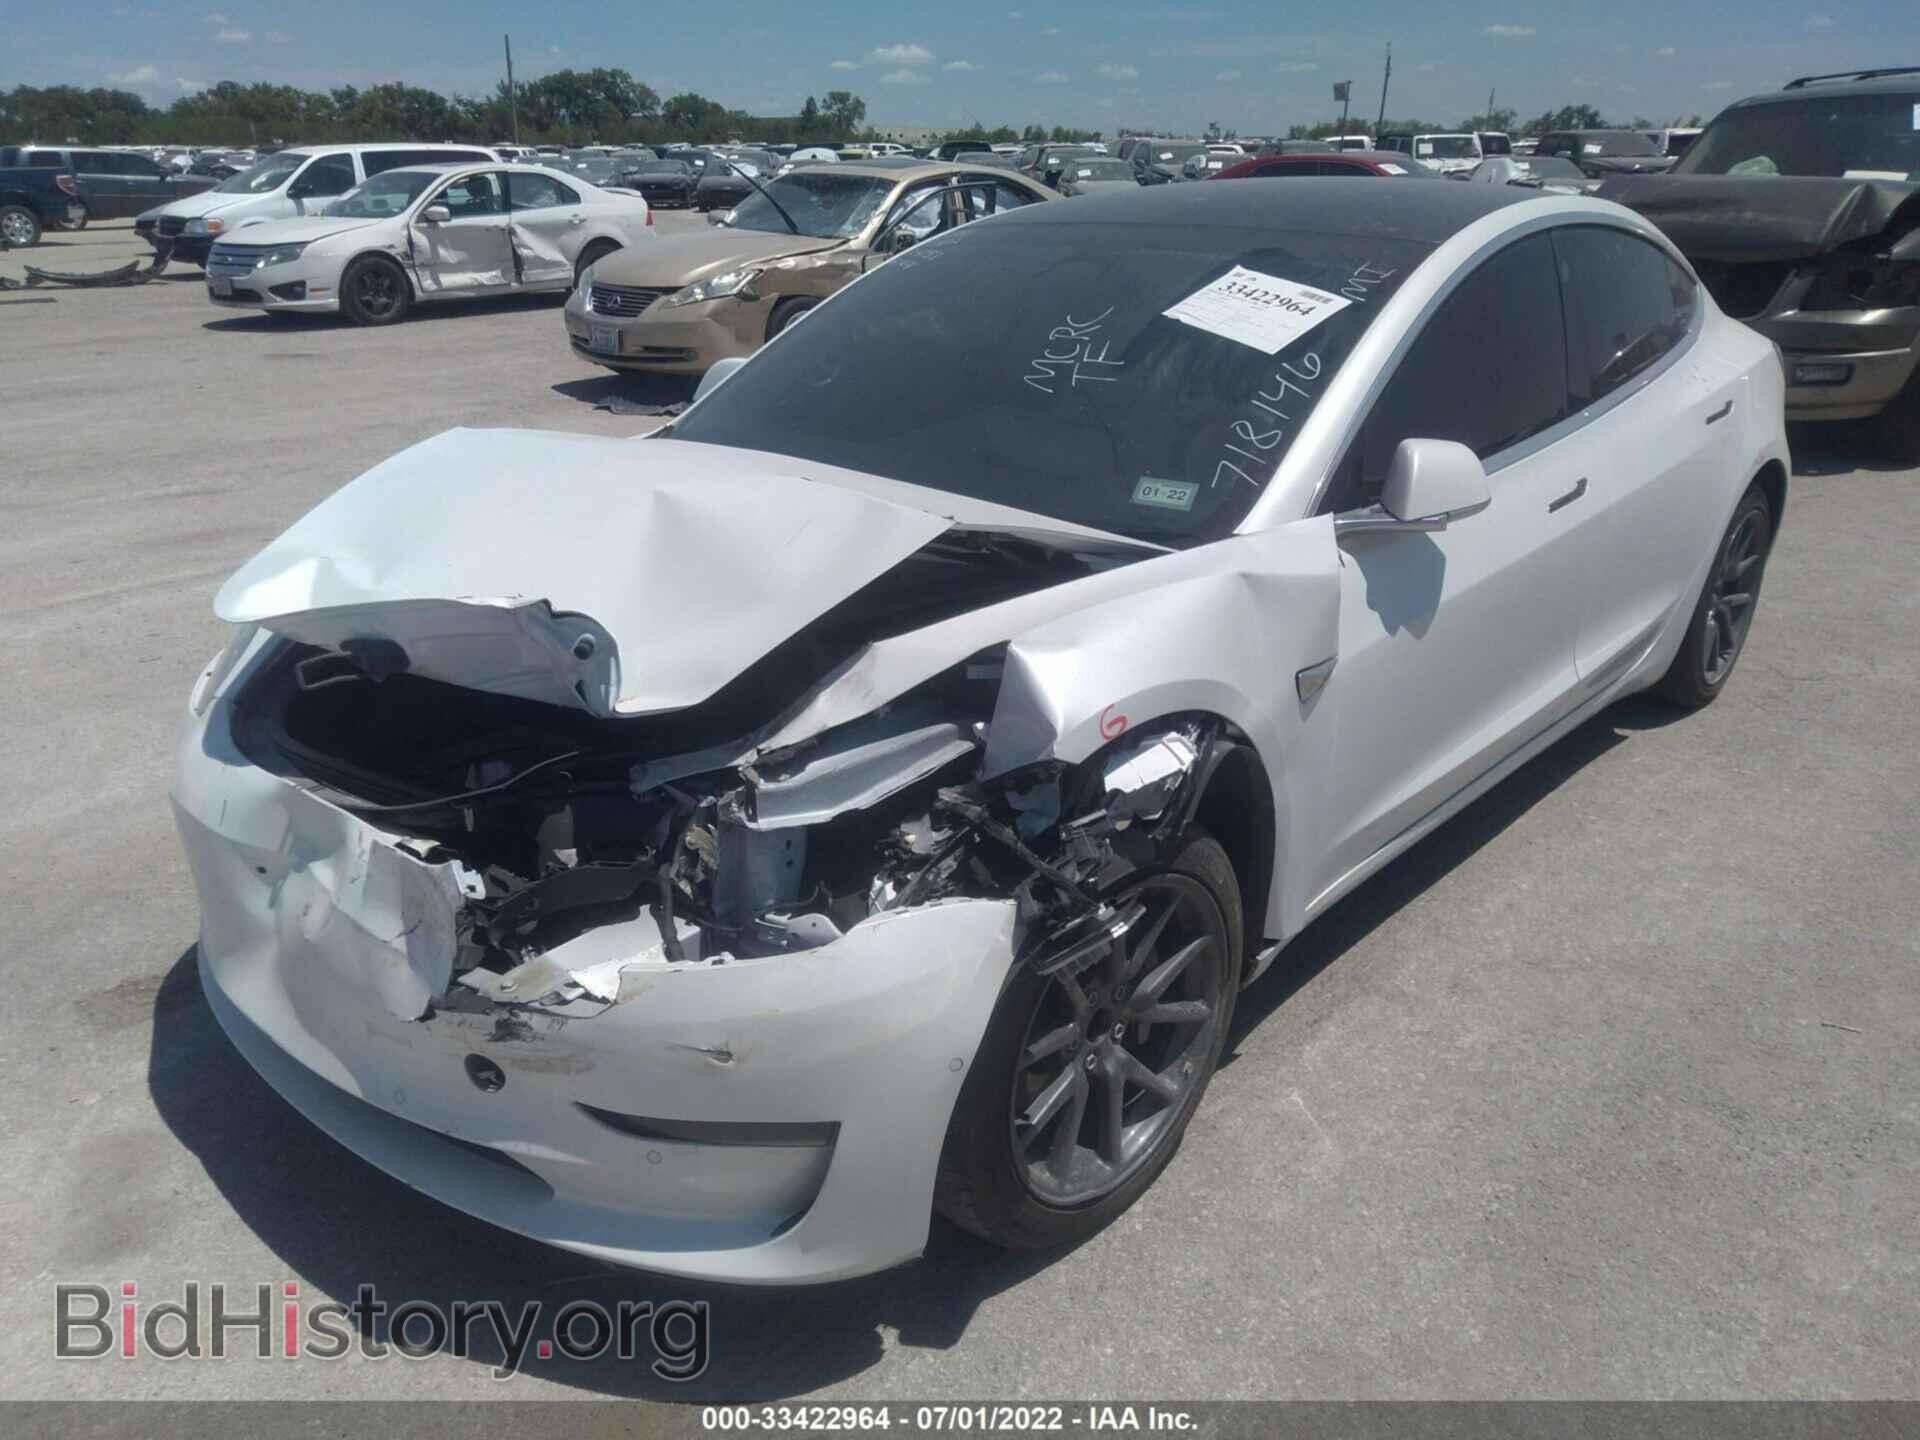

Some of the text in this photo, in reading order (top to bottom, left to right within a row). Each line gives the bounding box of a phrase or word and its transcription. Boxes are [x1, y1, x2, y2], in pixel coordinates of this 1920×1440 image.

[1218, 281, 1318, 317] 33422964
[1024, 306, 1115, 393] MCRC
[1072, 340, 1125, 388] TF
[1210, 353, 1322, 488] 718146
